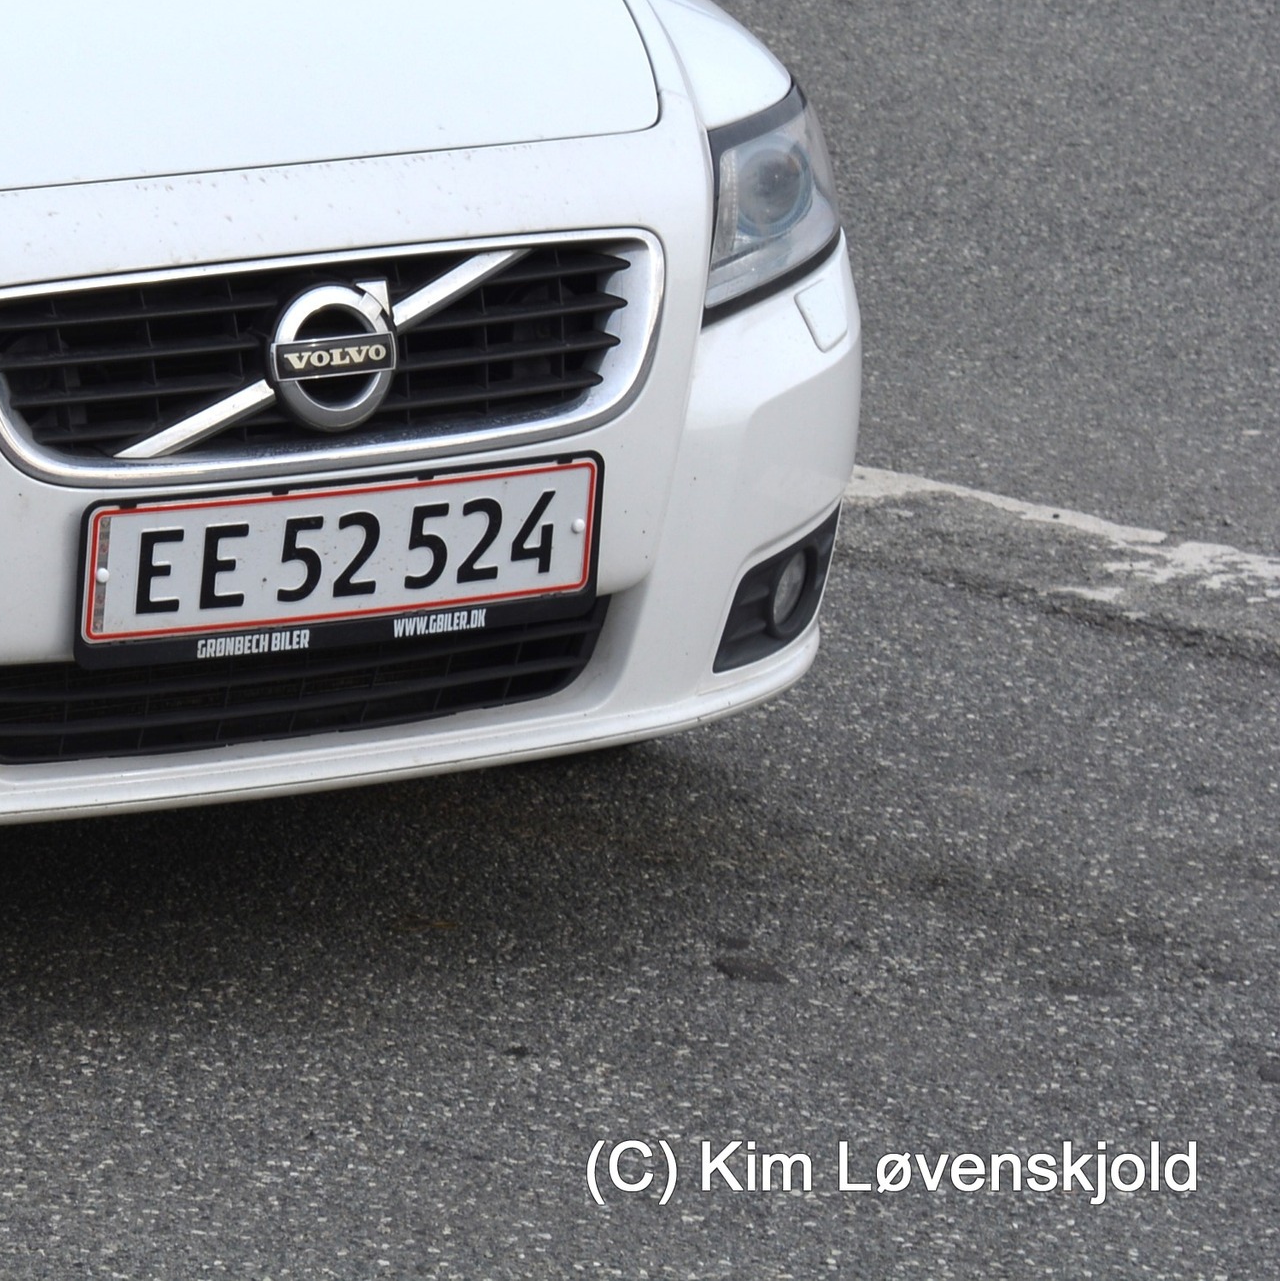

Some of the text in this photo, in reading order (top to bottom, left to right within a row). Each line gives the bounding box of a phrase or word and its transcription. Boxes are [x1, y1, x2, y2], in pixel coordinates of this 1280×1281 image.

[283, 344, 387, 370] VOLVO
[136, 490, 556, 615] EE 52 524
[393, 608, 487, 638] WWW.GBILER.DK
[196, 628, 311, 659] GRØNBECH BILER
